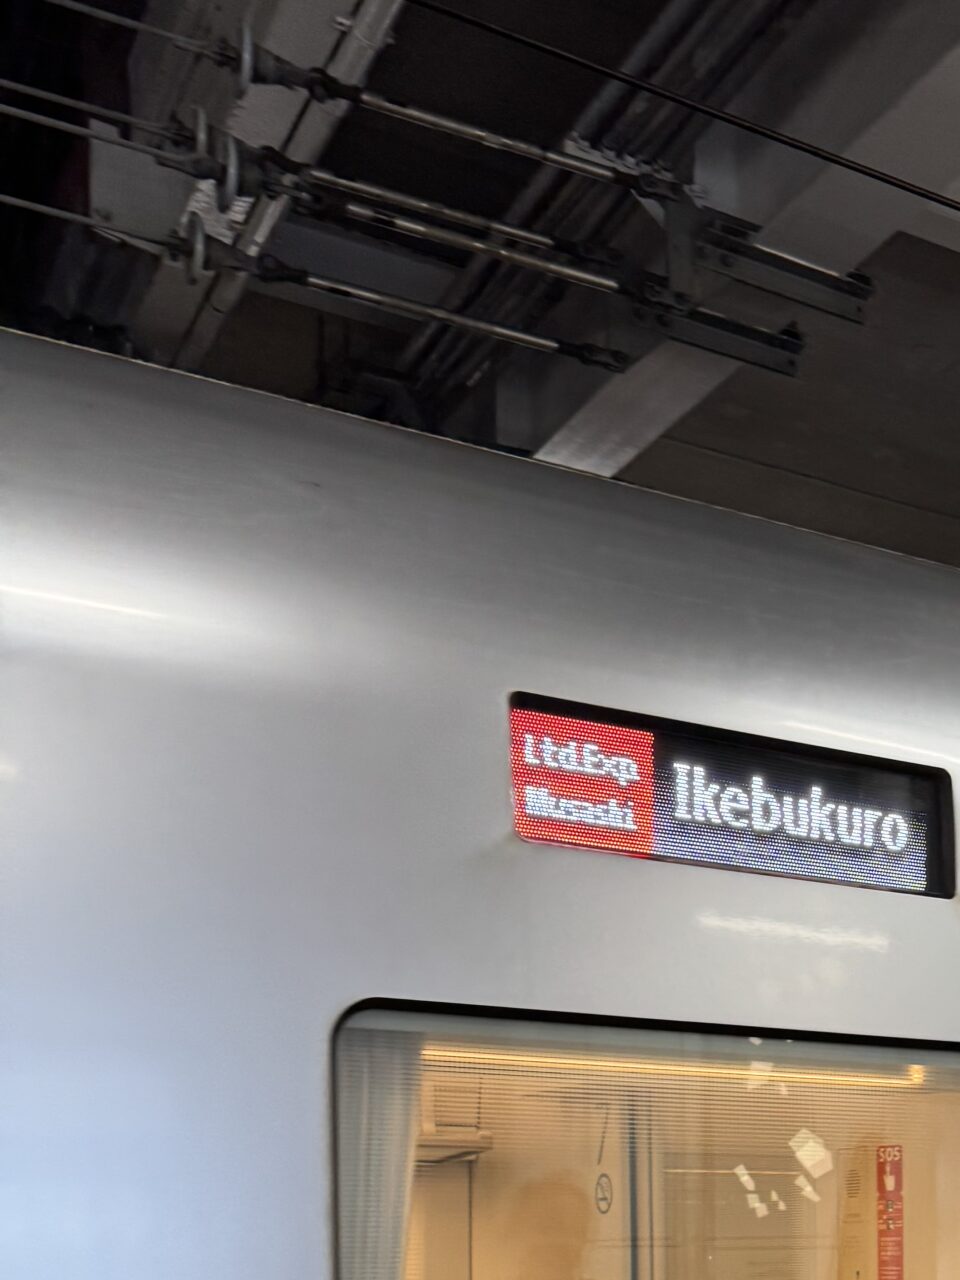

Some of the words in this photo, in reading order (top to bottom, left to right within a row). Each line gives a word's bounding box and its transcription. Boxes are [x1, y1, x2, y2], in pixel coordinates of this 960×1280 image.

[525, 786, 638, 830] Musashi
[673, 761, 909, 851] Ikebukuro
[878, 1146, 900, 1161] SOS
